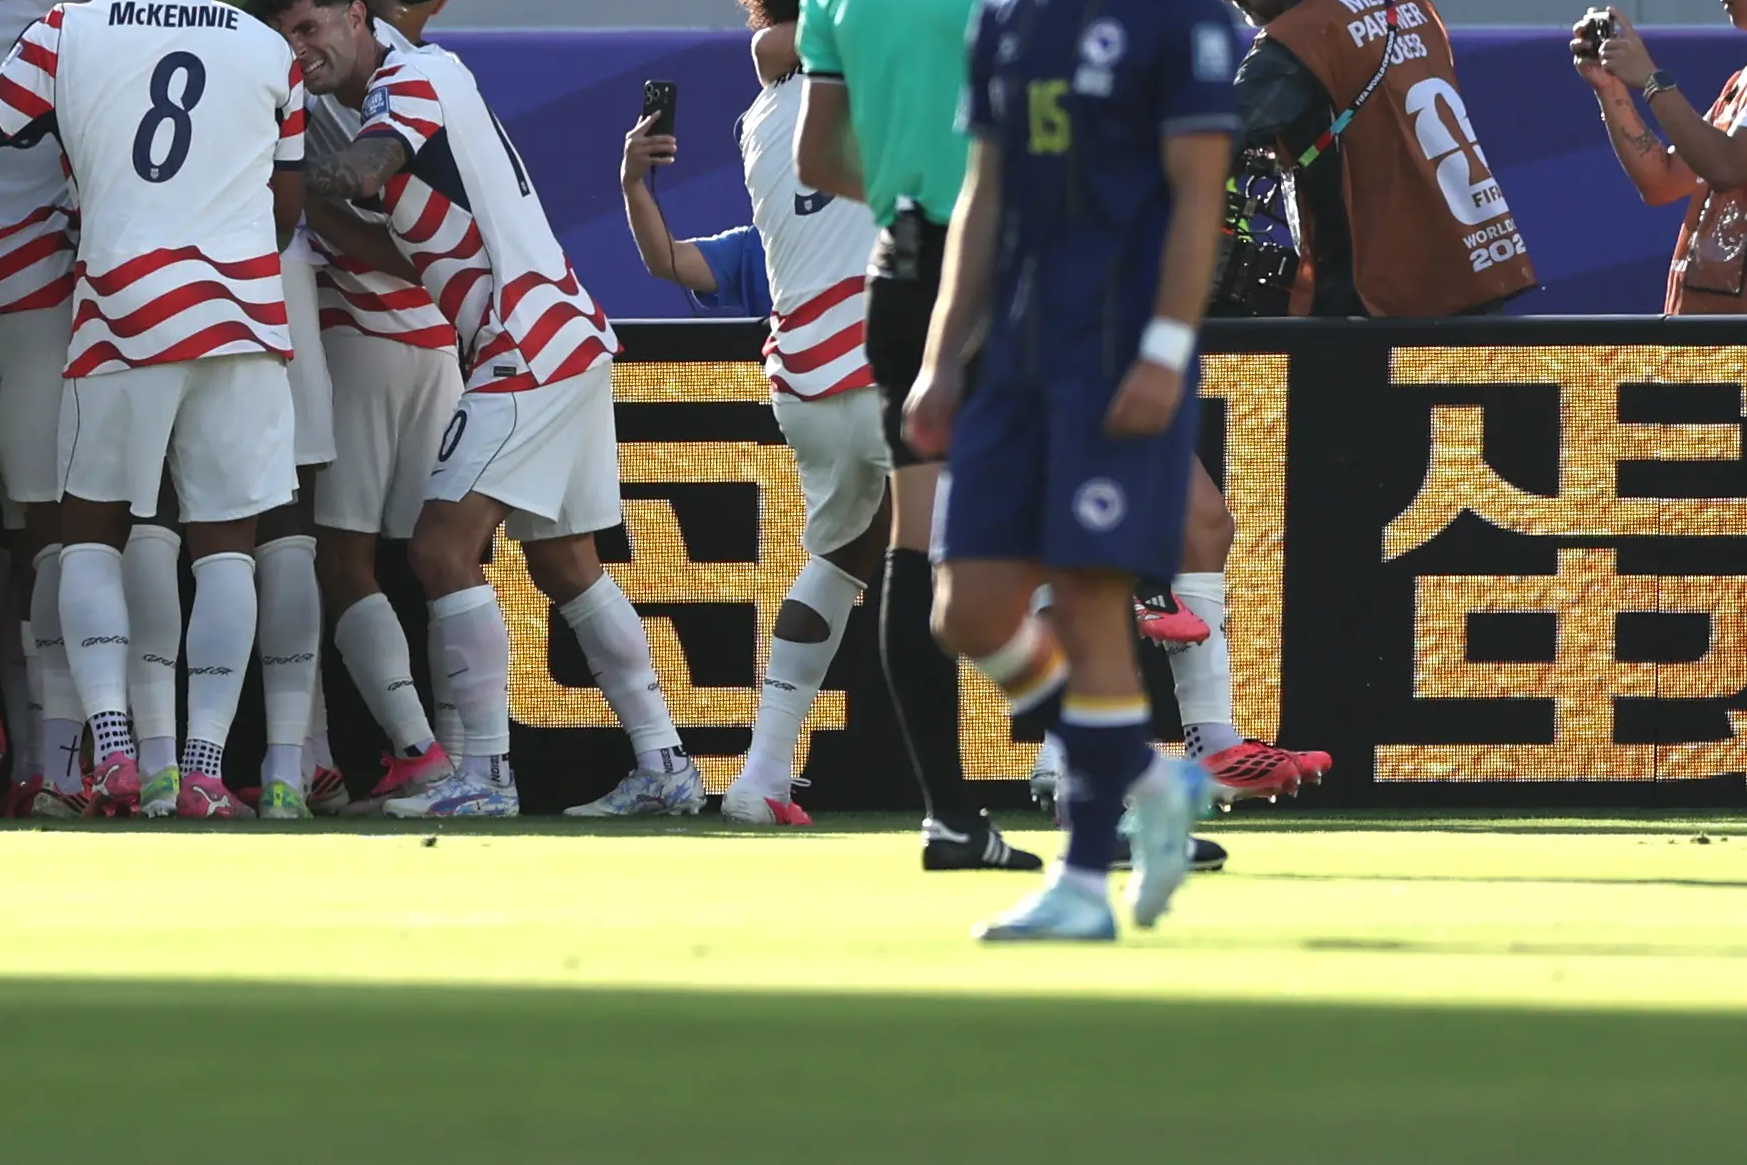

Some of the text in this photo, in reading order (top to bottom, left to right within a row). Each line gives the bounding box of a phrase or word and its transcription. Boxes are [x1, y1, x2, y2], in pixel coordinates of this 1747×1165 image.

[108, 1, 239, 31] McKENNIE
[1347, 2, 1428, 47] PARNER
[1355, 90, 1369, 106] FIFA
[1366, 67, 1385, 91] WORLD
[132, 51, 206, 183] 8
